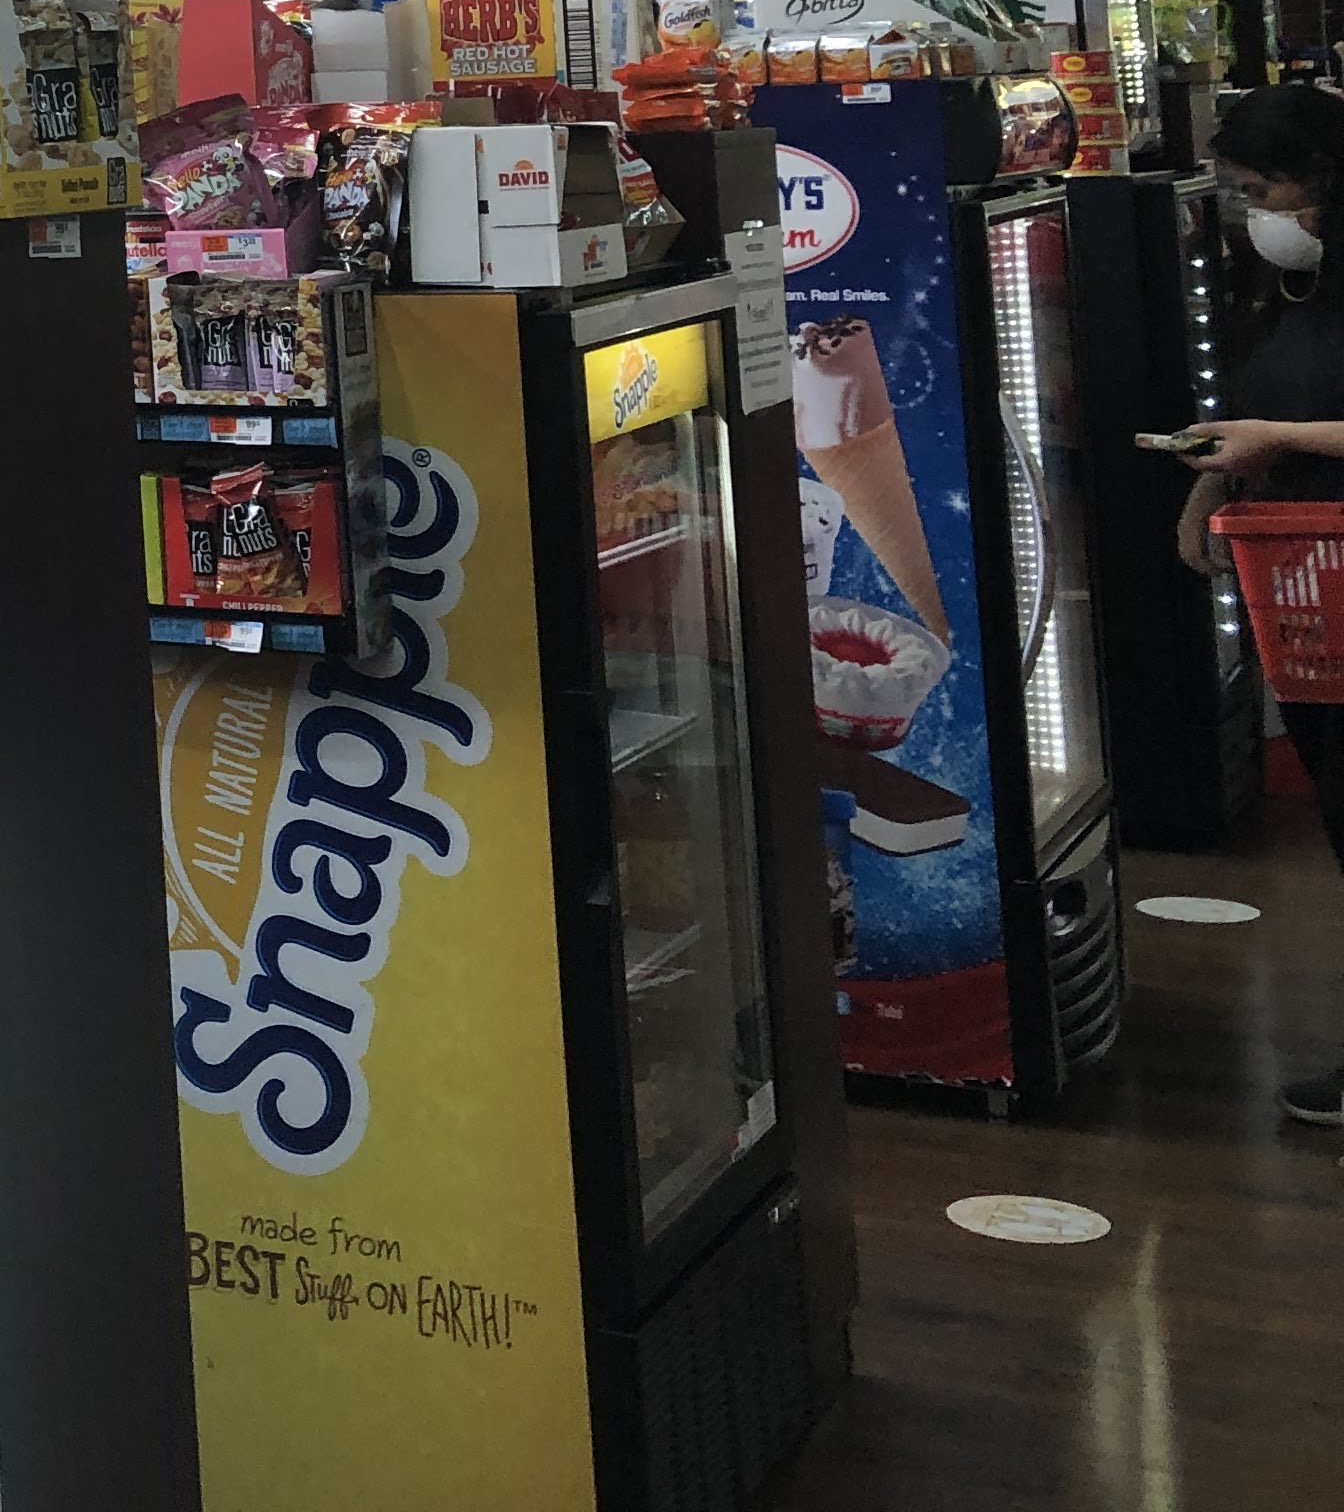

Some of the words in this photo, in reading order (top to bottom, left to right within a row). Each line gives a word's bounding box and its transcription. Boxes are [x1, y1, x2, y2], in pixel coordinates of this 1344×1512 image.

[664, 5, 712, 30] Goldfish
[453, 47, 490, 62] RED
[493, 45, 530, 60] HOT
[450, 59, 536, 76] SAUSAGE
[499, 171, 550, 187] DAVID
[127, 243, 167, 257] utella
[811, 289, 840, 301] Real
[843, 288, 891, 302] Smiles.
[614, 353, 659, 429] Snapple
[204, 685, 274, 817] NATURAL
[191, 823, 244, 885] ALL
[240, 1210, 318, 1247] made
[327, 1217, 403, 1264] from
[185, 1230, 286, 1301] BEST
[294, 1255, 360, 1321] Stuff
[365, 1282, 409, 1316] ON
